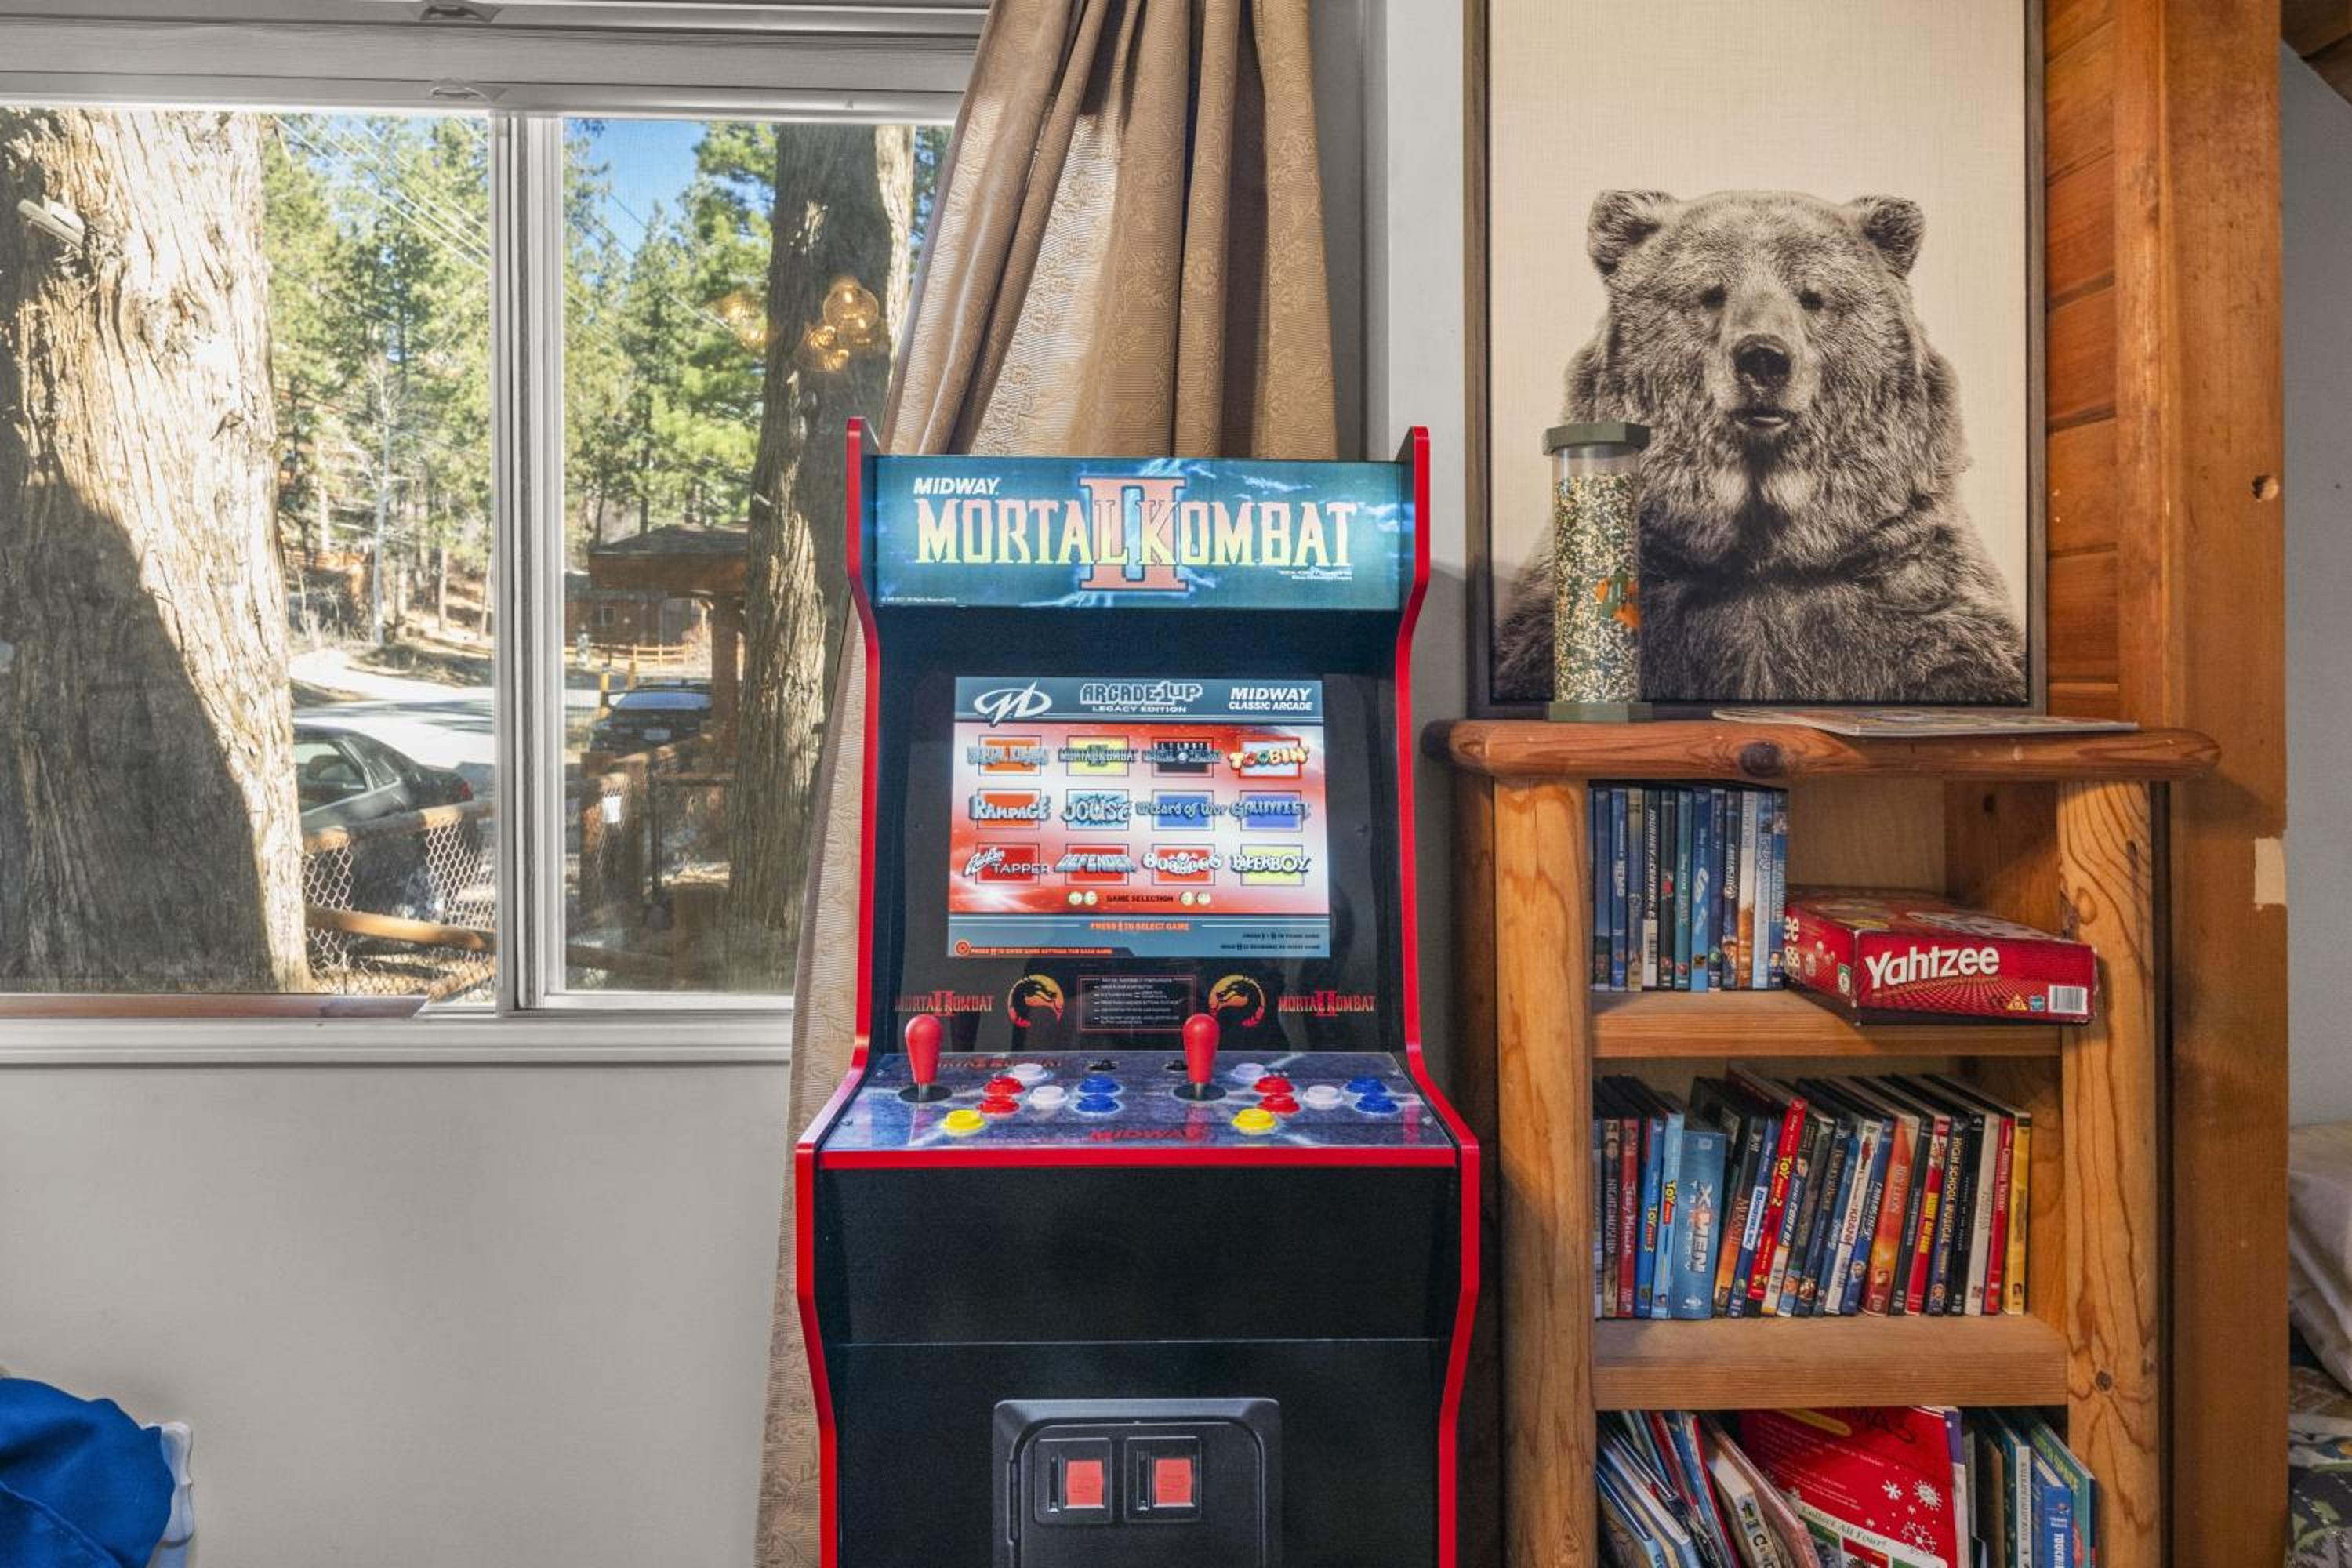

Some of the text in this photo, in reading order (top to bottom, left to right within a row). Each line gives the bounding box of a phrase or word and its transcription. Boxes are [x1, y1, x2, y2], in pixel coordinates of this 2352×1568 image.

[913, 478, 1000, 495] MIDWAY
[915, 498, 1359, 567] MORTAL KOMBAT
[1229, 701, 1313, 711] CLASSIC ARCADE
[1230, 688, 1312, 701] MIDWAY
[992, 863, 1050, 875] TAPPER
[1864, 946, 2000, 989] Yahtzee
[1278, 995, 1376, 1013] MORTAL KOMBAT
[1951, 1137, 1964, 1164] HIGH
[1778, 1155, 1794, 1181] TOY
[1664, 1179, 1676, 1205] TOY
[1947, 1163, 1959, 1201] SCHOOL
[1647, 1205, 1658, 1227] TOY
[1692, 1179, 1713, 1274] X-MEN
[1940, 1203, 1955, 1244] MUSICAL
